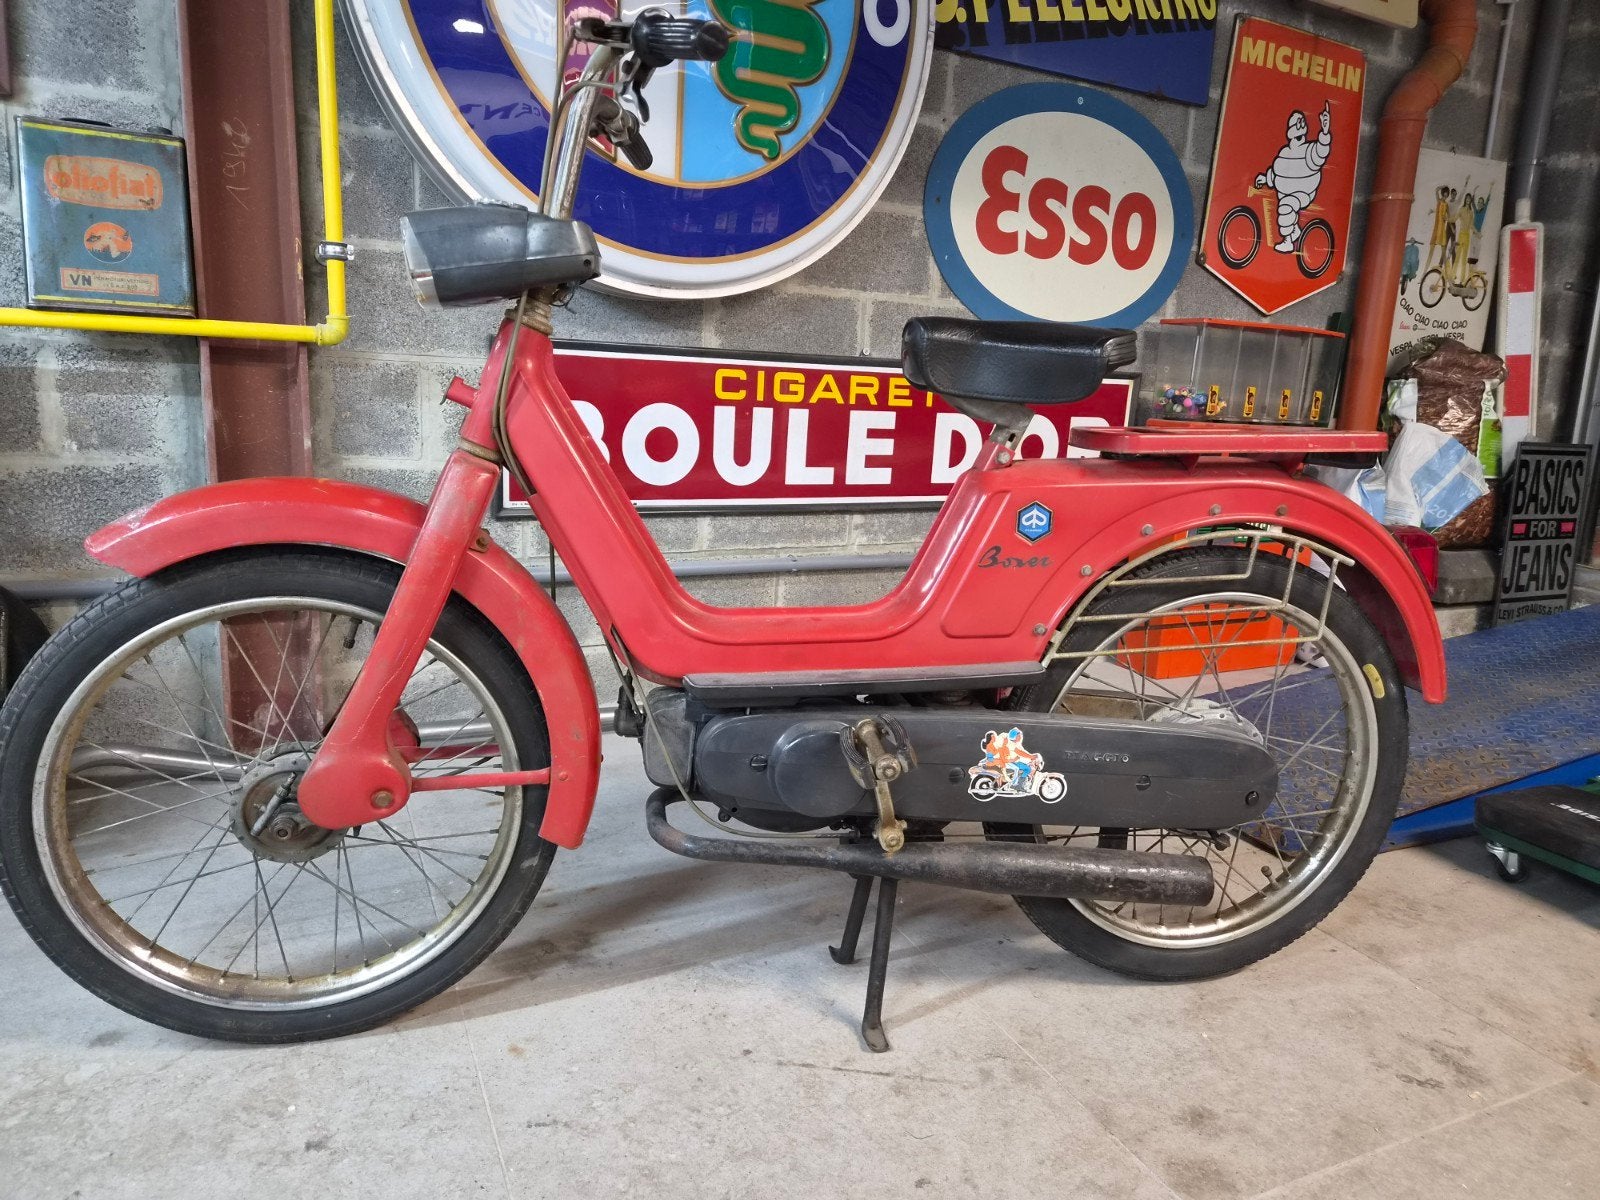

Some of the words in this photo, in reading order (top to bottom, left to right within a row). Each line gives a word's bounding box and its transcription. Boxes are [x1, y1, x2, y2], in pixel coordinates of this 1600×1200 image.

[1240, 36, 1362, 92] MICHELIN
[69, 273, 92, 286] VN
[1399, 297, 1414, 315] CIAO
[1414, 312, 1430, 326] CIAO
[1432, 319, 1449, 330] CIAO
[1451, 319, 1468, 330] CIAO
[1389, 341, 1413, 356] VESPA
[571, 399, 897, 486] OULE
[1513, 459, 1584, 515] BASICS
[1528, 520, 1558, 538] FOR
[1501, 543, 1572, 594] JEANS
[1498, 609, 1515, 620] LEVI
